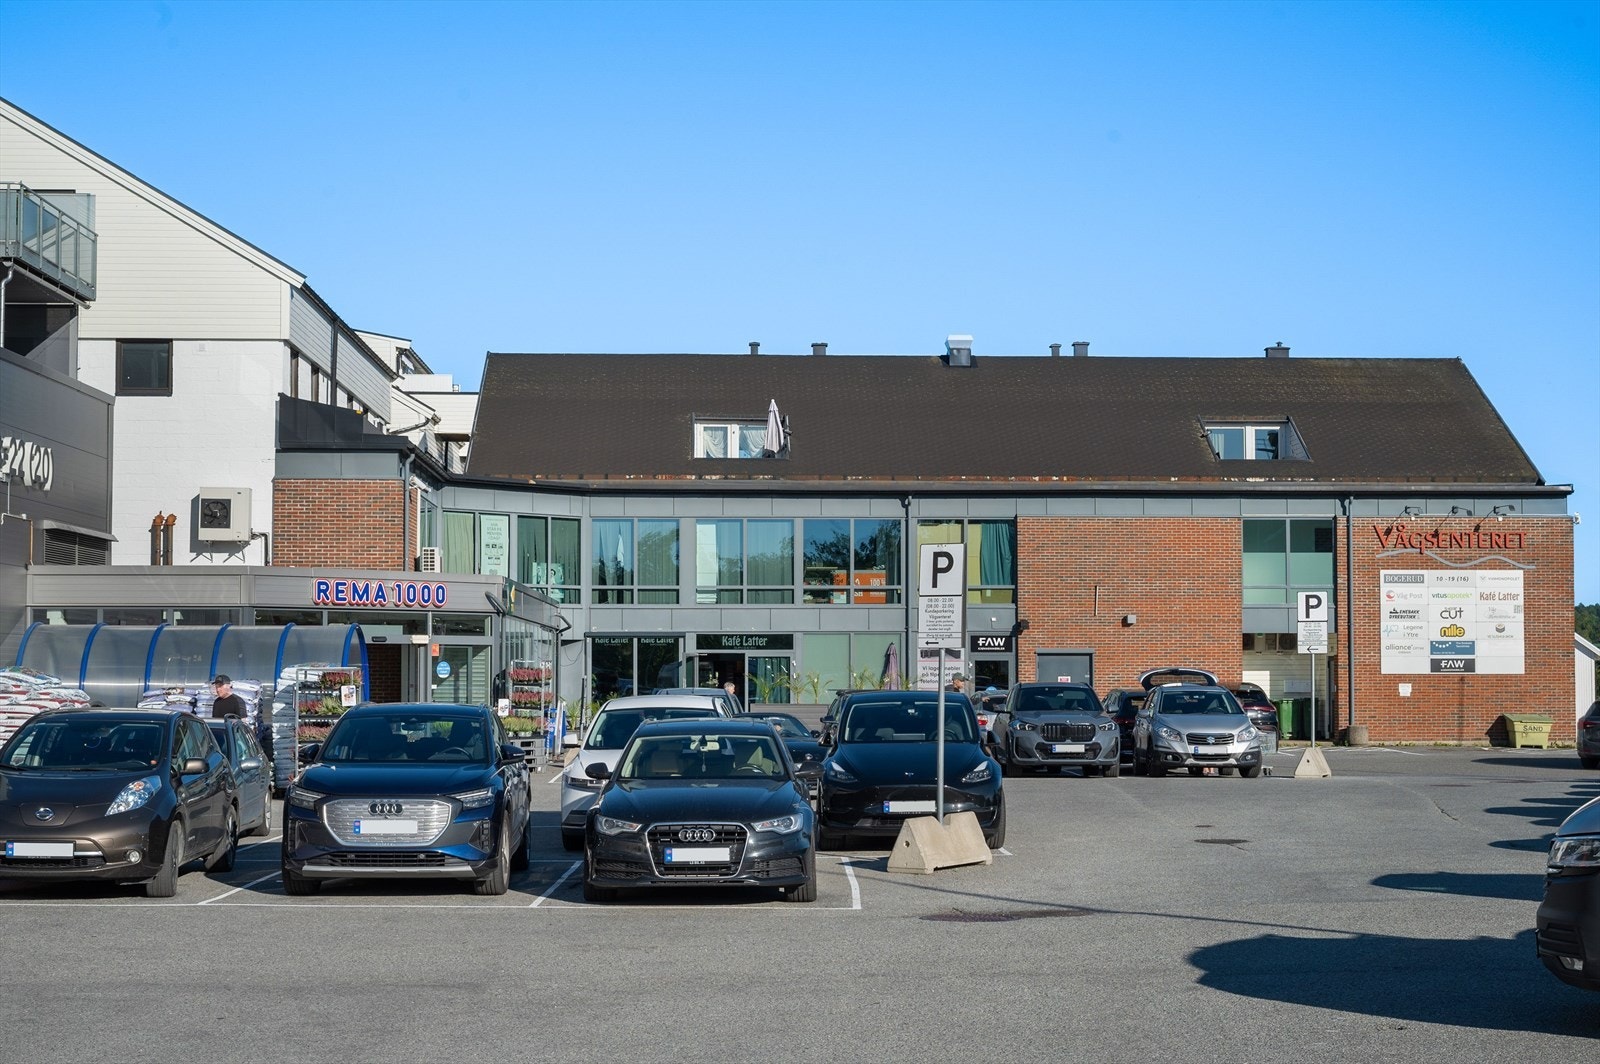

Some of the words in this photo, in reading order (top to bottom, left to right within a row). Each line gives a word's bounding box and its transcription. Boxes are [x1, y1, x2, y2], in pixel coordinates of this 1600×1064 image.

[932, 551, 954, 588] P
[1385, 574, 1423, 583] BOGERUD
[313, 577, 388, 607] REMA
[393, 580, 448, 608] 1000
[1480, 590, 1496, 600] Kafé
[1498, 591, 1520, 601] Latter
[1305, 594, 1322, 619] P
[1440, 623, 1465, 638] nille
[722, 635, 741, 646] Kafé
[742, 635, 767, 646] Latter
[978, 637, 1005, 646] FAW
[1441, 660, 1464, 668] FAW
